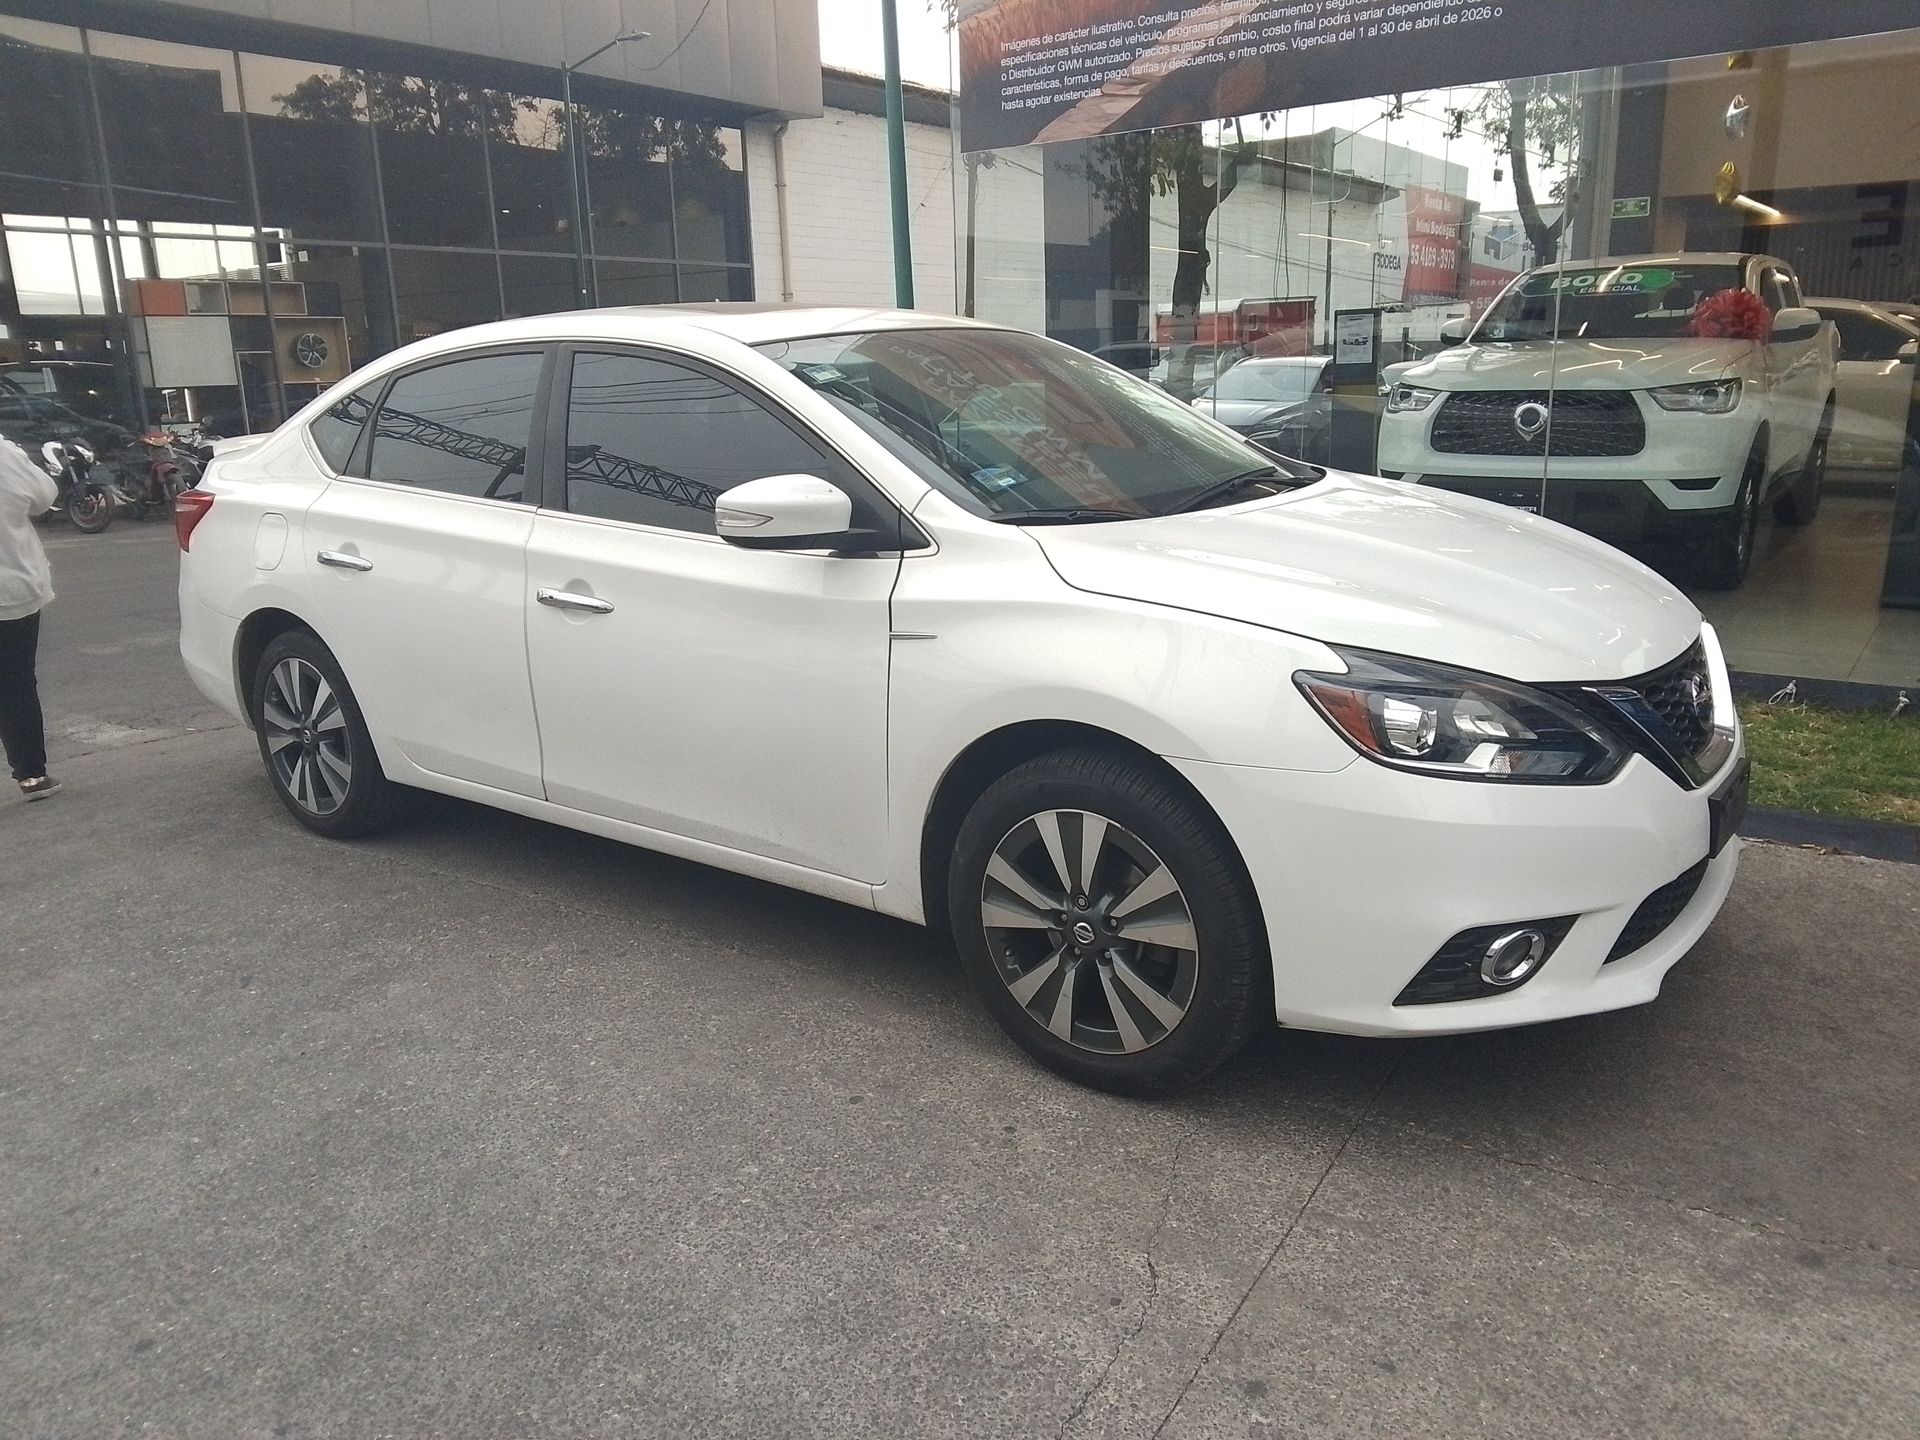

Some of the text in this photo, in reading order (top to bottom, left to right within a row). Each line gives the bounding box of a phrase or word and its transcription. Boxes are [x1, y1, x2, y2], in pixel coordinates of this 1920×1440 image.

[1001, 37, 1041, 52] Imágenes
[1042, 35, 1054, 44] de
[1054, 28, 1090, 42] carácter
[1091, 19, 1135, 35] ilustrativo.
[1138, 10, 1179, 27] Consulta
[1181, 5, 1218, 22] precios,
[1001, 48, 1069, 67] especificaciones
[1071, 40, 1107, 55] técnicas
[1109, 36, 1122, 48] del
[1125, 29, 1164, 46] vehículo,
[1168, 20, 1218, 40] programas
[1220, 18, 1234, 28] de
[1239, 3, 1314, 25] financiamiento
[1316, 2, 1322, 14] y
[1001, 72, 1007, 81] o
[1008, 64, 1056, 80] Distribuidor
[1058, 59, 1082, 72] GWM
[1084, 50, 1132, 68] autorizado.
[1136, 44, 1169, 58] Precios
[1172, 40, 1206, 54] sujetos
[1208, 38, 1215, 46] a
[1217, 30, 1259, 45] cambio,
[1262, 24, 1292, 37] costo
[1294, 18, 1316, 32] final
[1318, 10, 1350, 30] podrá
[1354, 8, 1384, 22] variar
[1002, 80, 1062, 96] características,
[1064, 74, 1088, 86] forma
[1091, 71, 1102, 80] de
[1104, 68, 1130, 82] pago,
[1132, 62, 1160, 75] tarifas
[1161, 62, 1168, 72] y
[1169, 52, 1226, 69] descuentos,
[1260, 42, 1288, 55] otros.
[1290, 33, 1336, 50] Vigencia
[1338, 28, 1356, 40] del
[1359, 26, 1364, 38] 1
[1368, 24, 1378, 37] al
[1380, 22, 1395, 34] 30
[1398, 20, 1412, 32] de
[1415, 14, 1440, 29] abril
[1442, 12, 1458, 24] de
[1461, 6, 1492, 22] 2026
[1494, 7, 1502, 16] o
[1002, 87, 1103, 110] hasta agotar existencias.
[1424, 193, 1442, 210] Renta
[1431, 220, 1456, 240] Bodegas
[1410, 244, 1420, 265] 55
